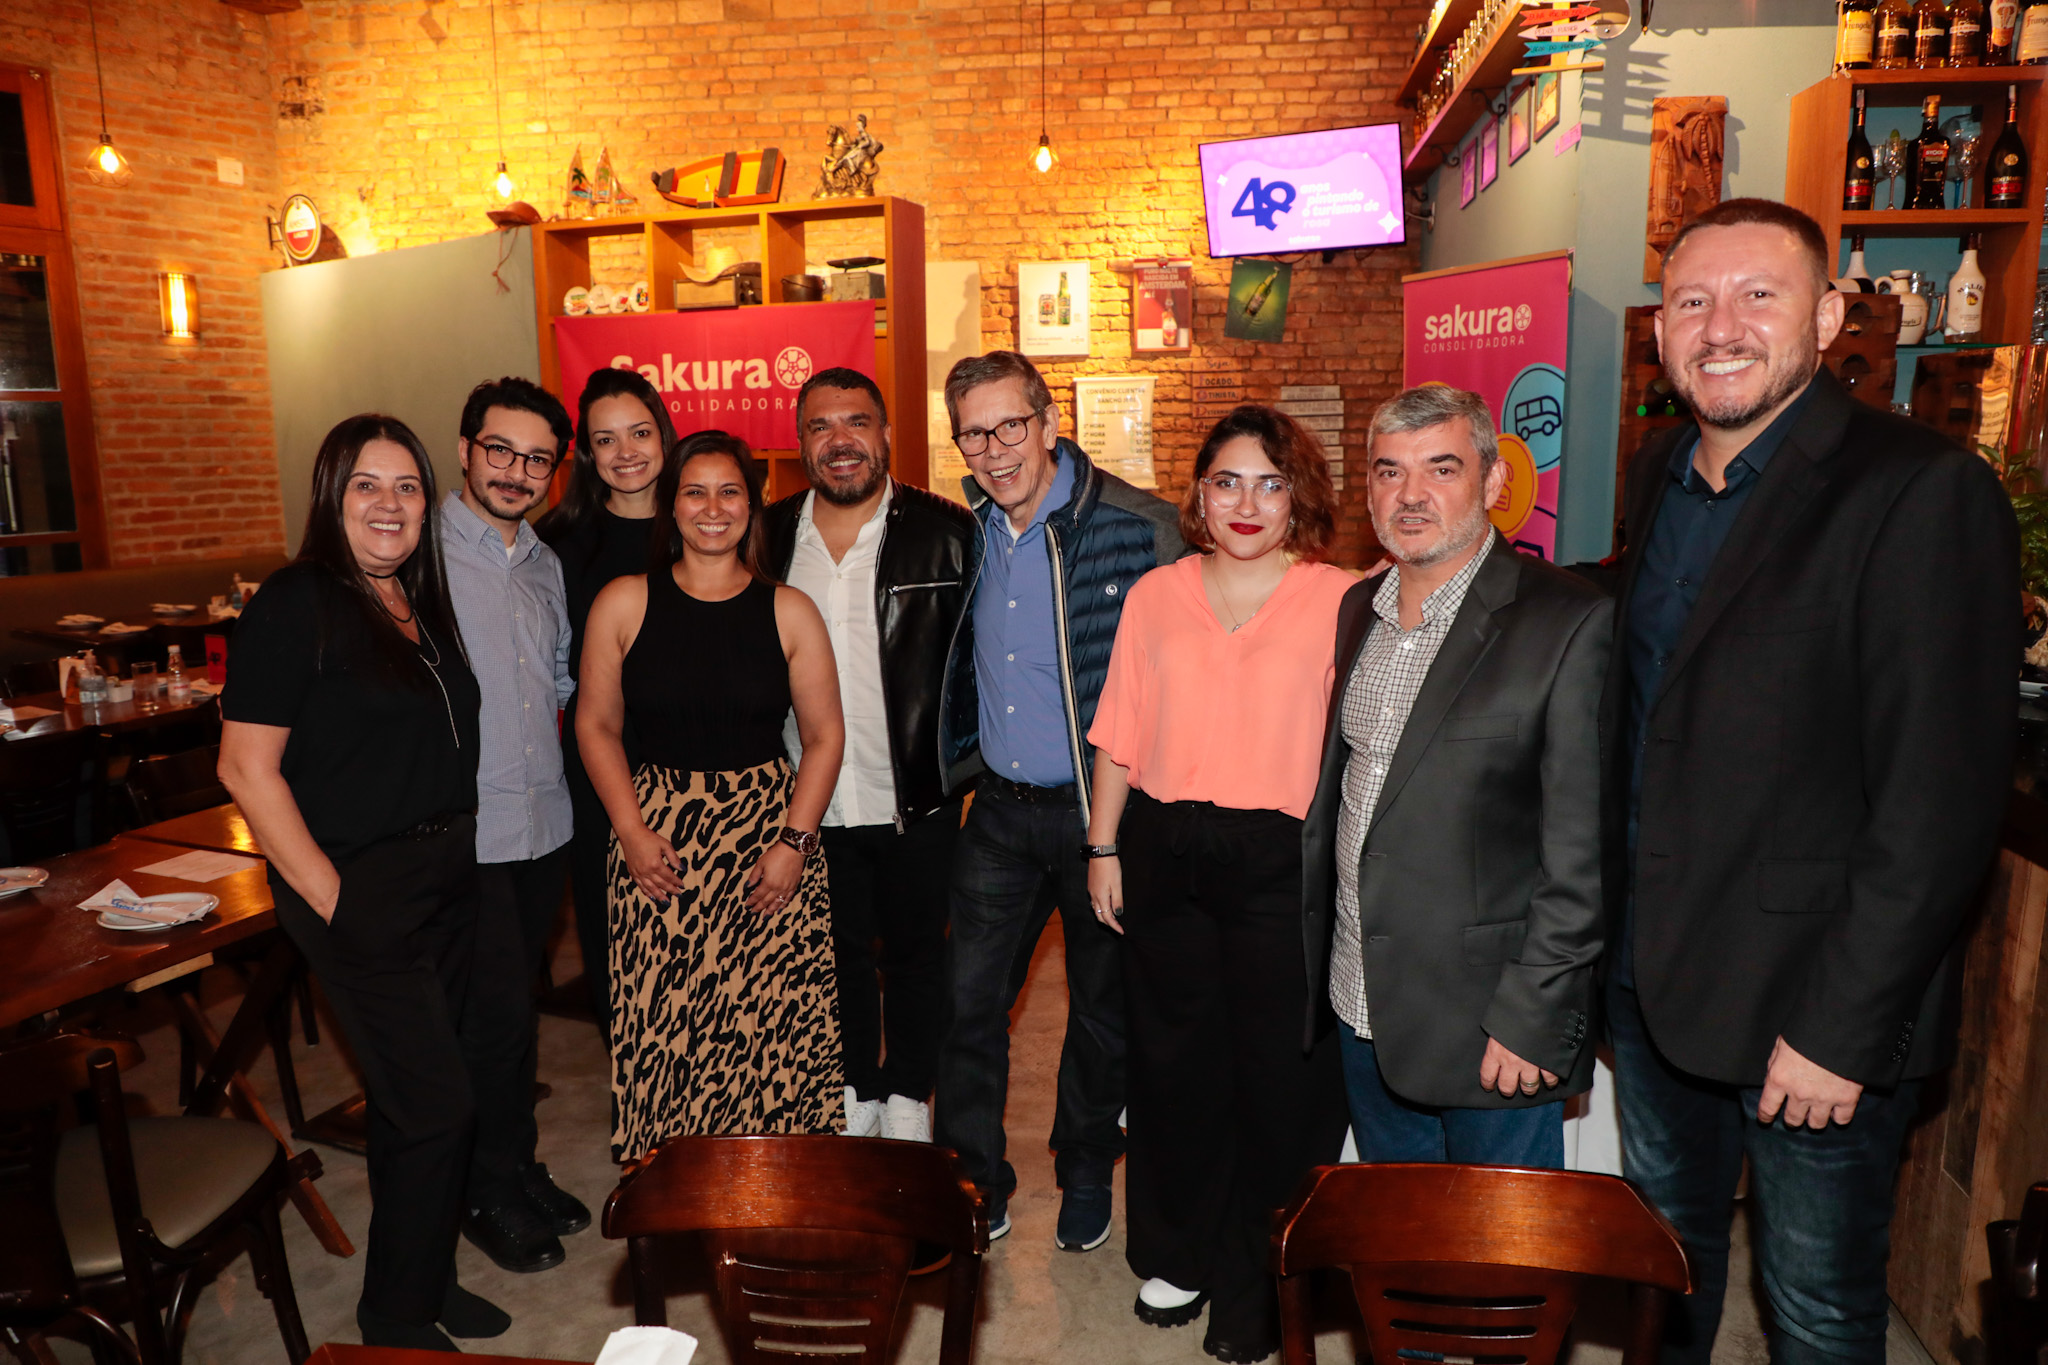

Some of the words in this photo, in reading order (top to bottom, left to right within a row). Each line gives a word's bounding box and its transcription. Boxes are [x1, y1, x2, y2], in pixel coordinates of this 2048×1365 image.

[1301, 183, 1330, 194] anos
[1307, 189, 1365, 208] pintando
[1302, 207, 1311, 218] o
[1312, 203, 1362, 217] turismo
[1364, 199, 1379, 212] de
[1424, 304, 1513, 340] sakura
[1424, 336, 1524, 353] CONSOLIDADORA
[671, 398, 797, 413] OLIDADORA
